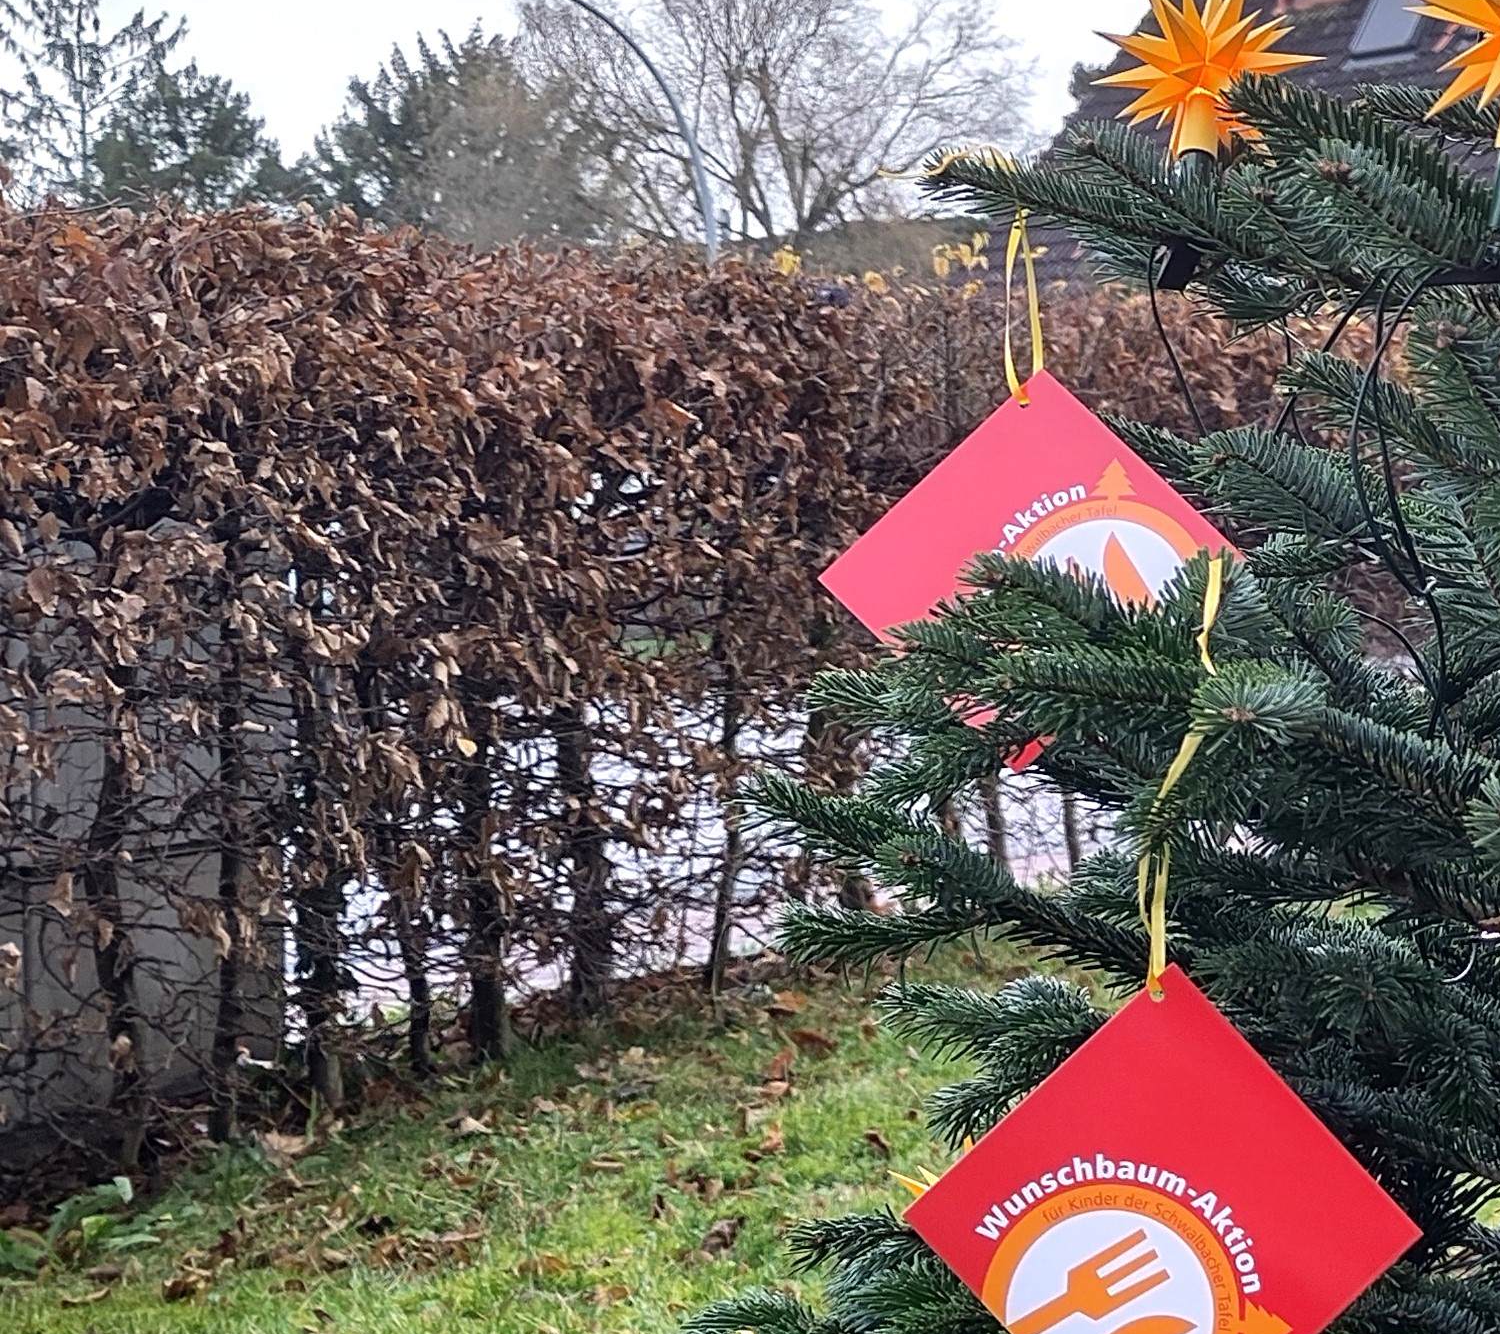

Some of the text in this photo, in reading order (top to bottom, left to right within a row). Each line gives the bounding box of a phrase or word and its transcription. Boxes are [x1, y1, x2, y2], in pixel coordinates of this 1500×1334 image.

[975, 1154, 1261, 1294] Wunschbaum-Aktion
[1068, 1192, 1119, 1210] Kinder
[1124, 1193, 1150, 1210] der
[1153, 1203, 1226, 1288] Schwalbacher
[1218, 1293, 1234, 1332] Tafel
